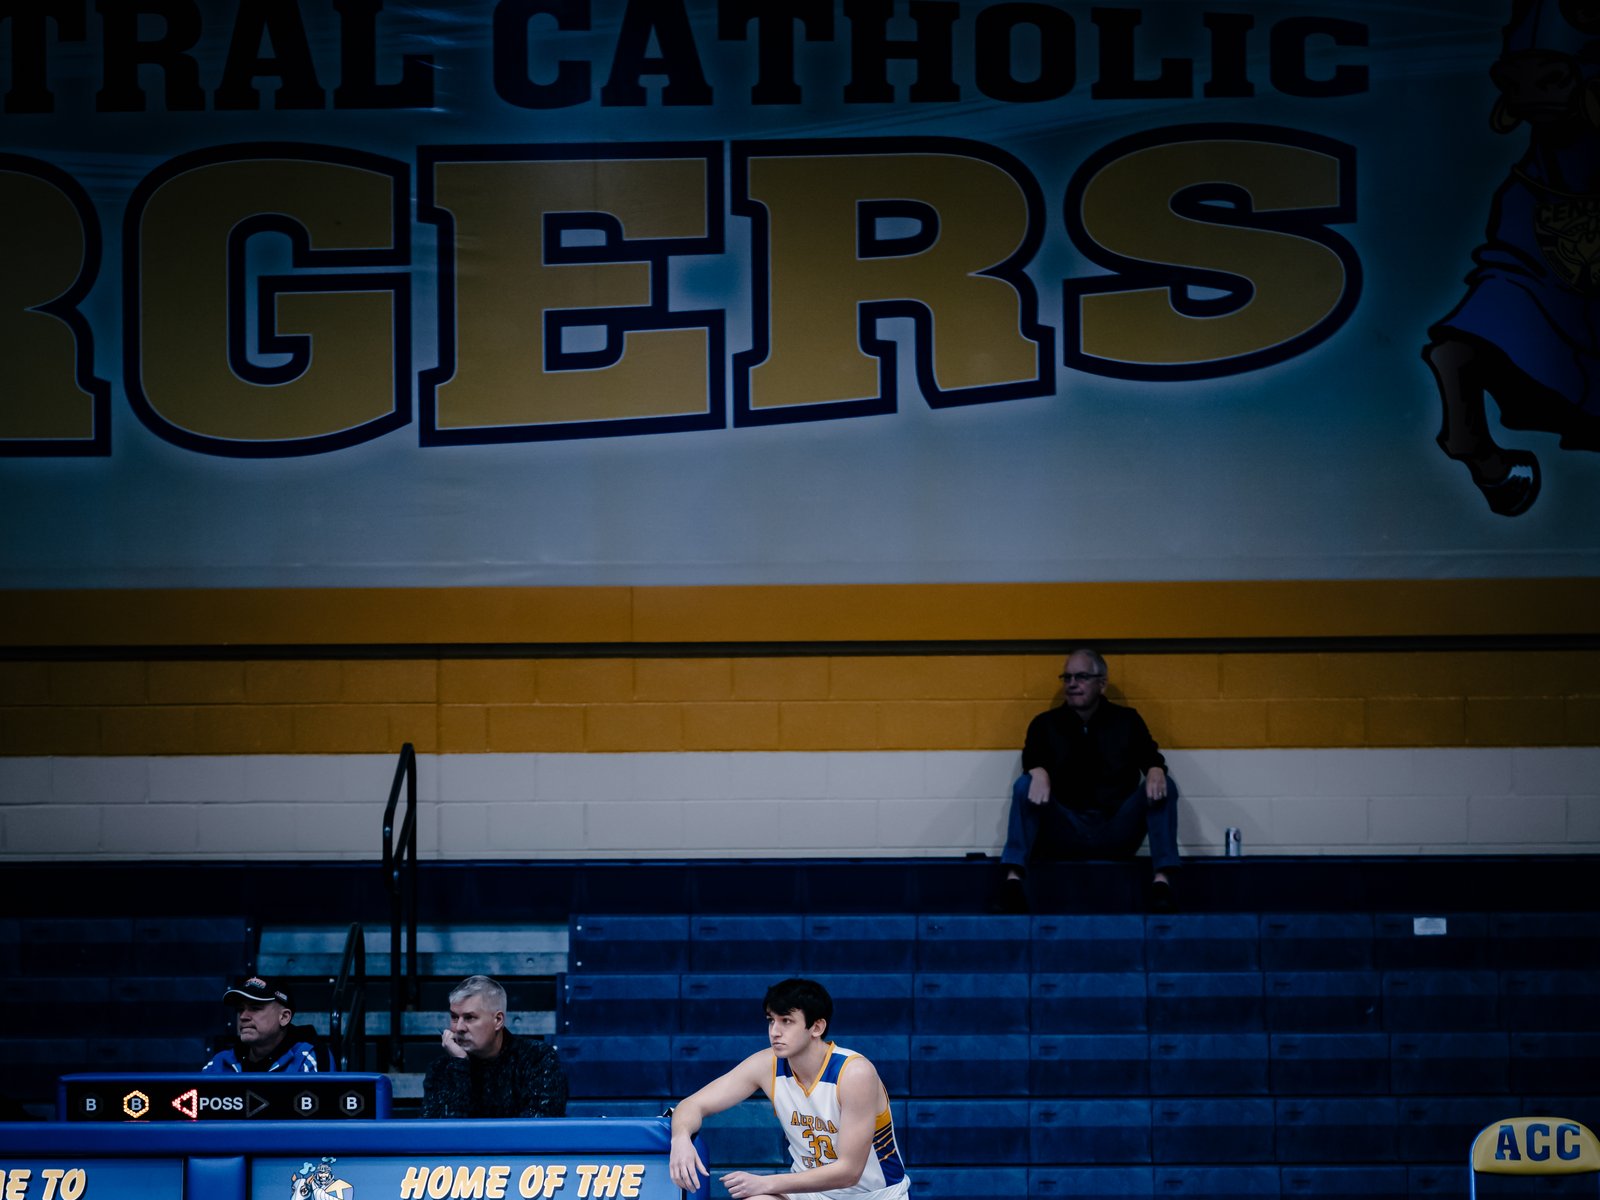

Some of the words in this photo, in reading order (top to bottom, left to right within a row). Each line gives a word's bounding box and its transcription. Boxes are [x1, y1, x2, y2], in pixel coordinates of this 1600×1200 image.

[492, 0, 1370, 110] CATHOLIC
[85, 1097, 97, 1112] B
[130, 1097, 142, 1112] B
[199, 1096, 243, 1111] POSS
[301, 1096, 312, 1111] B
[346, 1096, 358, 1111] B
[1494, 1123, 1581, 1162] ACC
[400, 1166, 511, 1200] HOME
[518, 1165, 567, 1199] OF
[576, 1164, 645, 1198] THE
